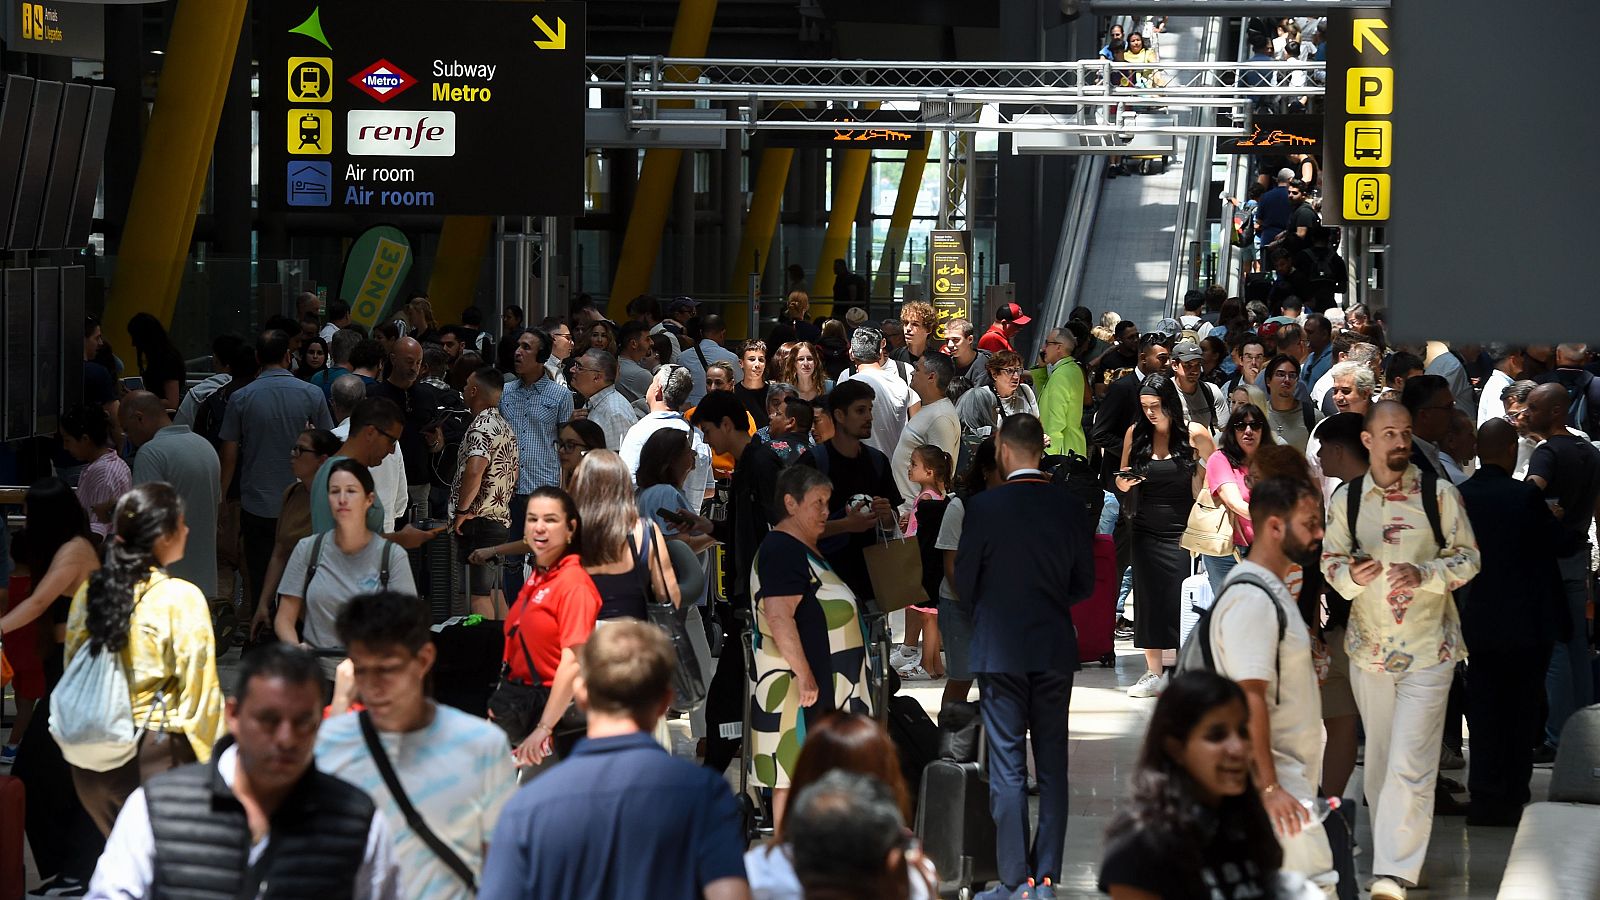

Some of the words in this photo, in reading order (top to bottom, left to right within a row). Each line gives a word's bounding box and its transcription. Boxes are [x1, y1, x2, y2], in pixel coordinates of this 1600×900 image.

[367, 75, 398, 86] Metro
[432, 59, 496, 81] Subway
[432, 82, 491, 102] Metro
[358, 116, 445, 150] renfe
[345, 163, 367, 181] Air
[372, 168, 415, 182] room
[344, 185, 374, 205] Air
[381, 190, 435, 206] room
[358, 246, 401, 318] ONCE
